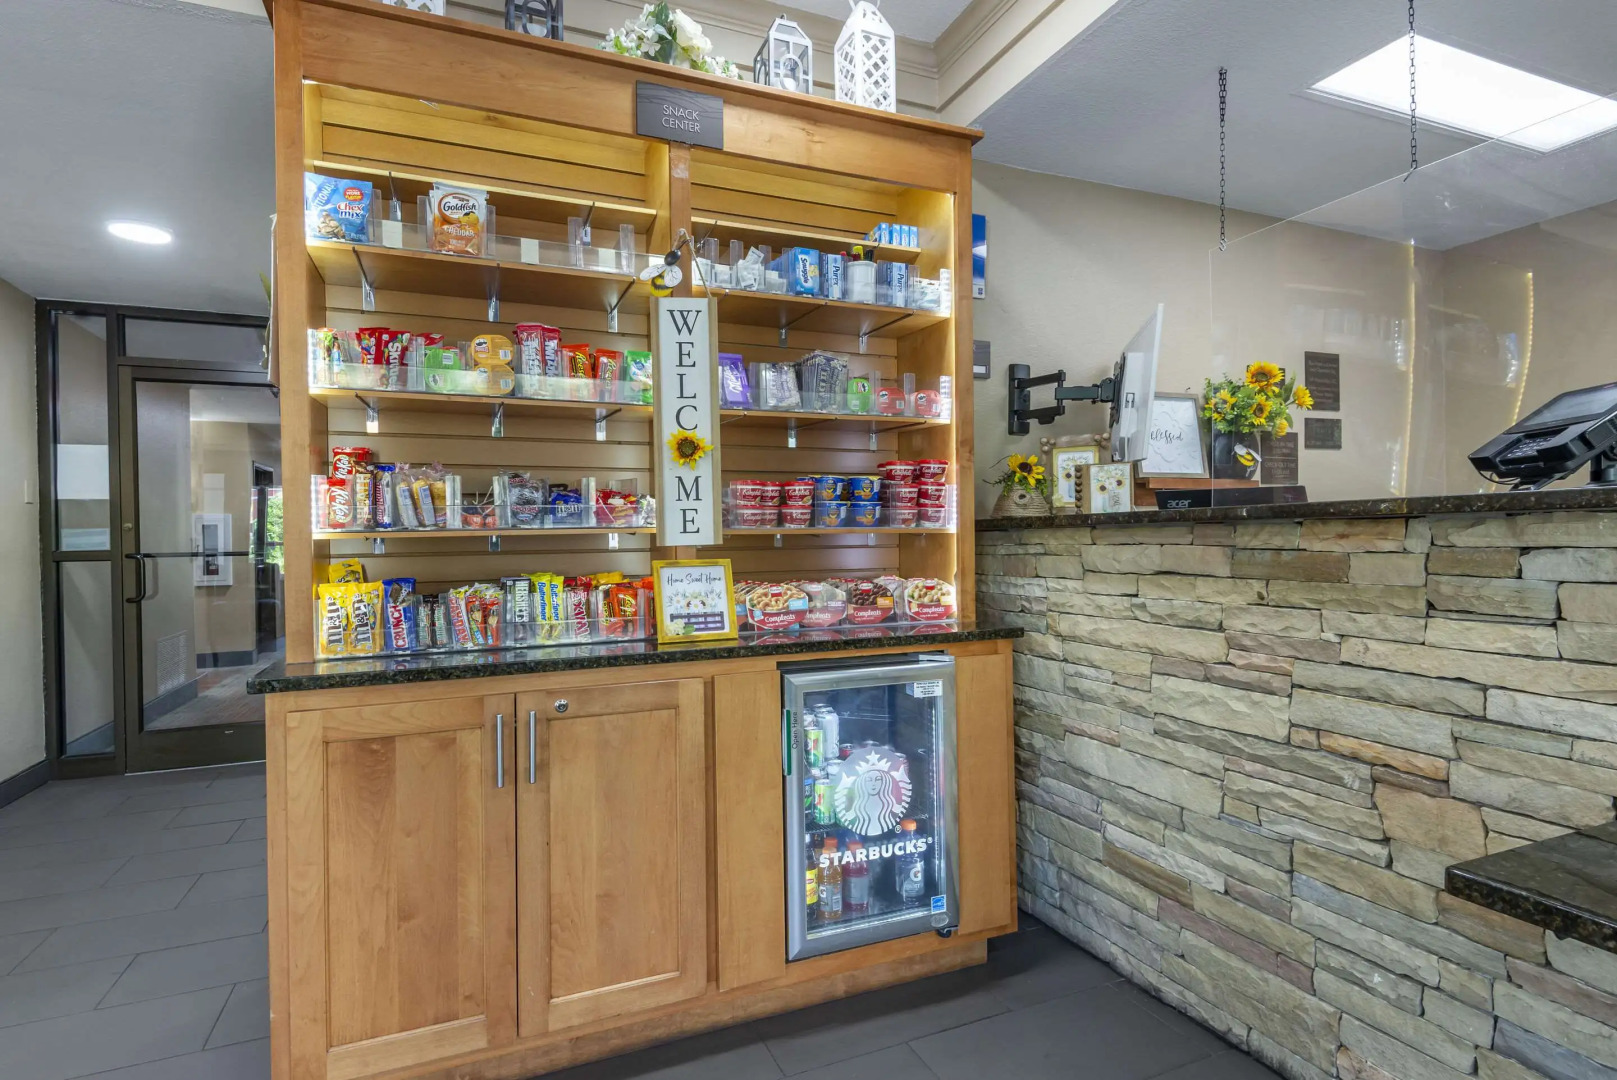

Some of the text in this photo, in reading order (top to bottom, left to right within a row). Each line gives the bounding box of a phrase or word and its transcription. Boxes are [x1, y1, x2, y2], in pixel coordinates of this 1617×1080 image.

[663, 104, 699, 120] SNACK
[662, 117, 700, 132] CENTER
[336, 201, 365, 211] Chex
[443, 201, 477, 212] Goldfish
[800, 257, 809, 284] Snuggle
[832, 265, 841, 286] Purex
[667, 309, 702, 534] WELCME
[1166, 499, 1191, 508] acer
[667, 572, 721, 586] Home Sweet Home
[854, 609, 882, 618] Compleats
[918, 606, 945, 615] Compleats
[765, 613, 796, 623] Compleats
[388, 604, 408, 648] CRUNCH
